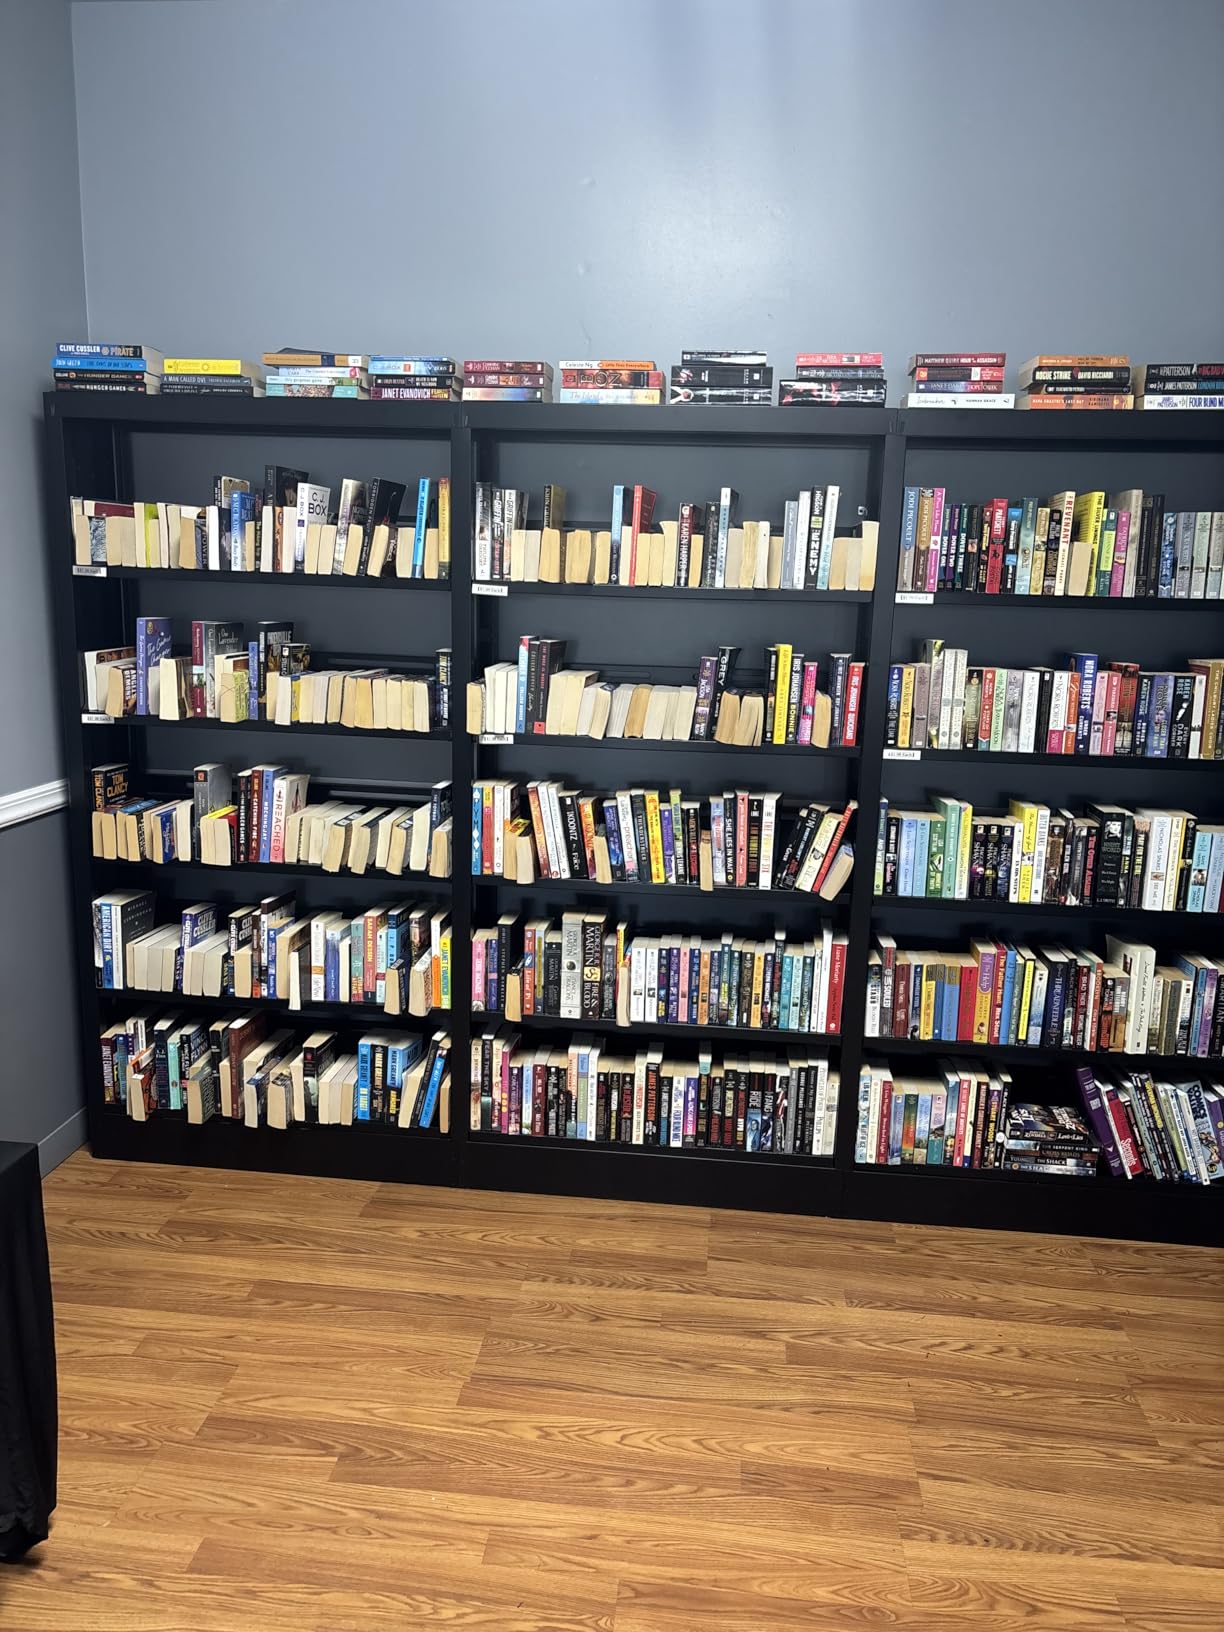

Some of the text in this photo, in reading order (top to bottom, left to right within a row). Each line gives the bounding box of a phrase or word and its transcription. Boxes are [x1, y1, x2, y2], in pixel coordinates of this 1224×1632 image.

[59, 344, 100, 354] CLIVE CUSSLER
[110, 346, 134, 357] PIRATE
[1036, 370, 1072, 380] ROGUE STRIKE
[1163, 366, 1191, 376] PATTERSON
[382, 388, 398, 398] JANET
[400, 388, 430, 398] EVANOVICH
[1188, 396, 1202, 408] FOUR
[308, 502, 327, 517] BOX
[368, 482, 378, 514] FORBIDDEN
[814, 490, 822, 514] HIGSON
[494, 500, 502, 524] GRIFFIN
[906, 490, 916, 542] JODI PICOULT
[994, 509, 1002, 534] PRATCHETT
[1062, 500, 1072, 545] REVENANT
[921, 515, 929, 541] PICOULT
[679, 522, 690, 569] KAREN HARPER
[809, 534, 820, 576] ENEMY
[718, 656, 728, 686] GREY
[790, 658, 801, 704] IRIS JOHANSEN
[698, 678, 708, 698] JACKSON
[1082, 660, 1094, 709] NORA ROBERTS
[848, 686, 858, 712] JOHANSEN
[1052, 684, 1064, 728] NORA ROBERTS
[788, 704, 796, 732] BONNIE
[273, 804, 282, 852] REACHED
[568, 814, 577, 840] KOONTZ
[637, 815, 646, 860] THUNDERSTRUCK
[726, 848, 732, 856] IN
[102, 906, 112, 952] AMERICAN DIRT
[585, 926, 594, 966] MARTIN
[441, 966, 449, 996] EVANOVICH
[832, 962, 842, 984] Moriarty
[980, 972, 990, 989] Help
[592, 998, 598, 1008] &
[1051, 978, 1062, 1028] THREADNEEDLE
[102, 1046, 113, 1087] JANET EVANOVICH
[648, 1072, 656, 1120] JAMES PATTERSON
[749, 1090, 758, 1107] RIDE
[764, 1095, 772, 1112] FANG
[1192, 1084, 1208, 1119] COMICS
[988, 1122, 996, 1142] WOODS
[1120, 1138, 1136, 1166] Seconds
